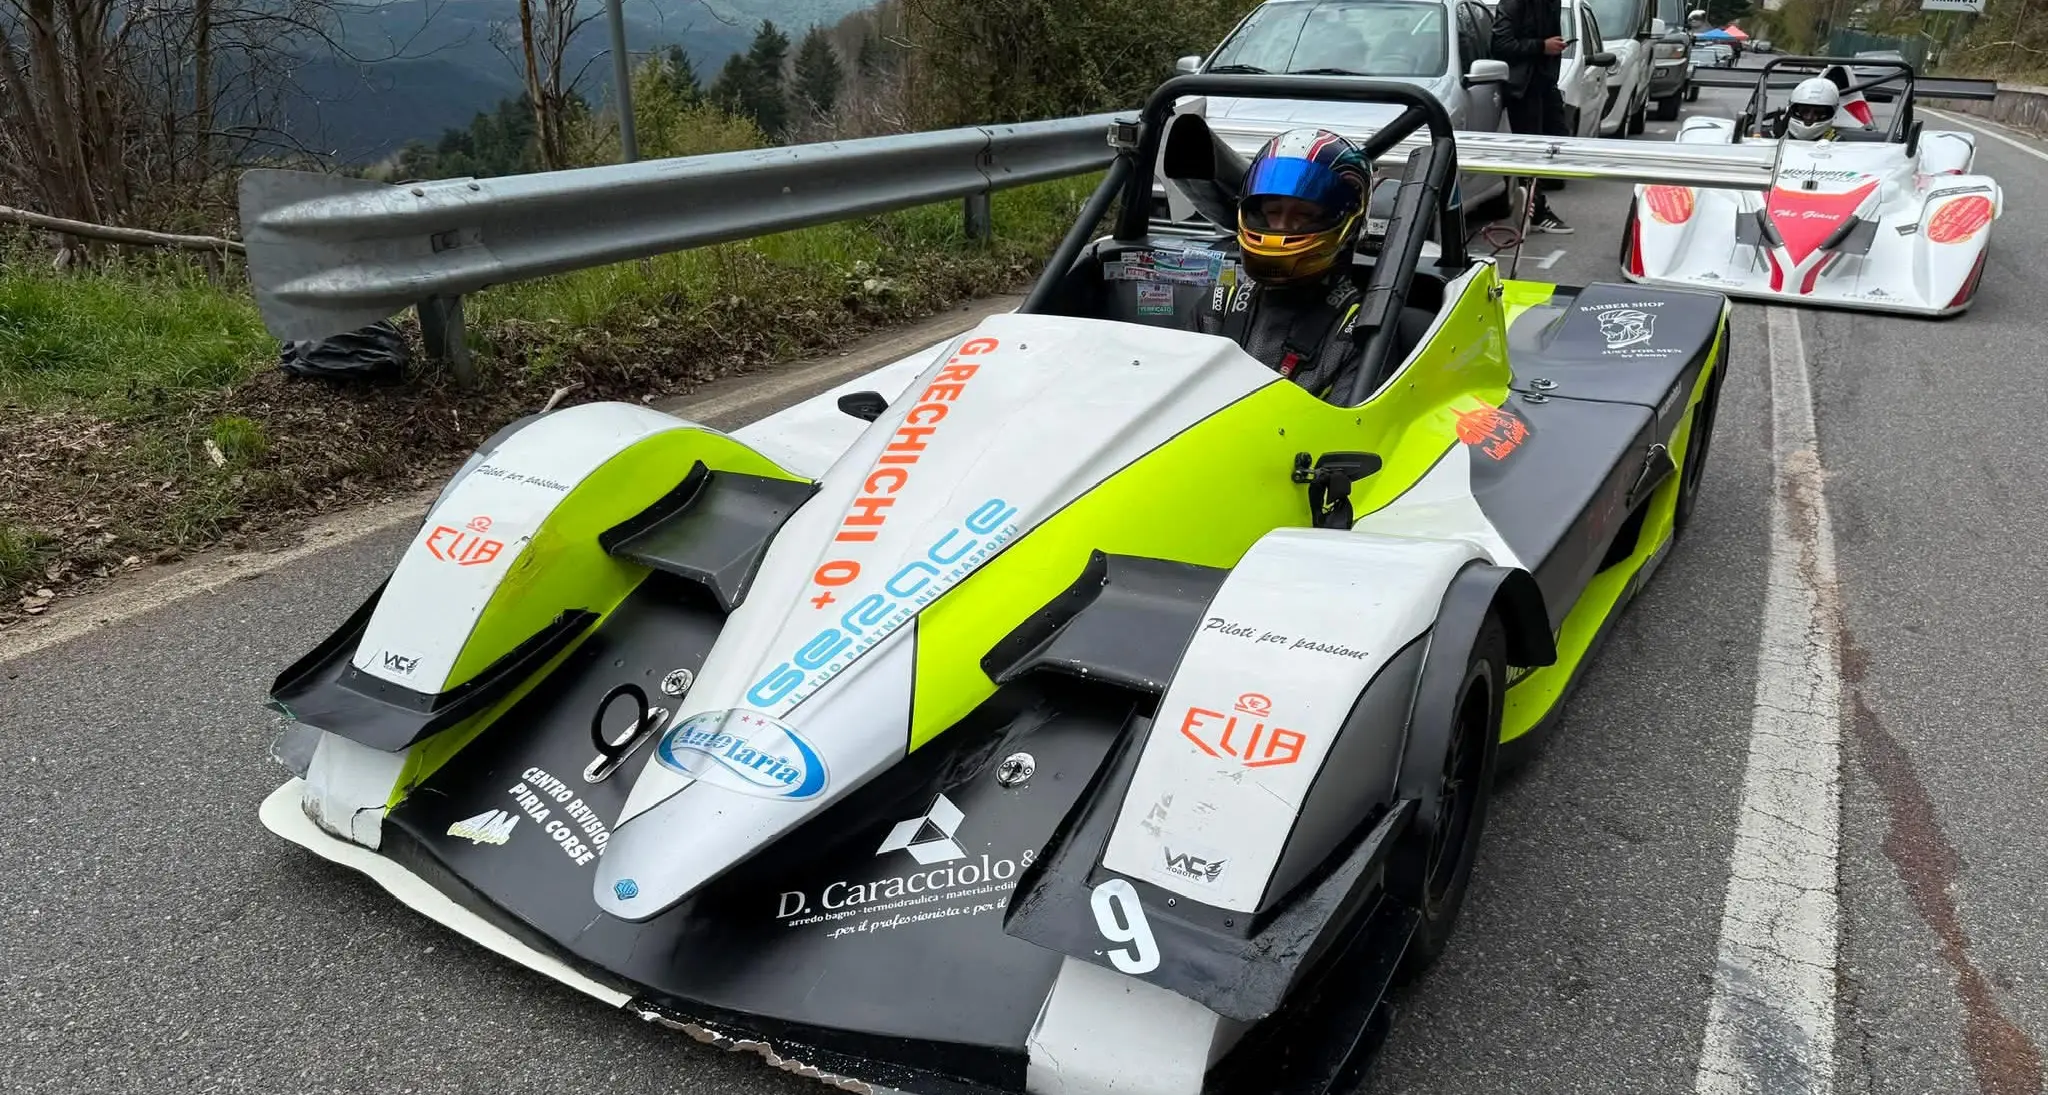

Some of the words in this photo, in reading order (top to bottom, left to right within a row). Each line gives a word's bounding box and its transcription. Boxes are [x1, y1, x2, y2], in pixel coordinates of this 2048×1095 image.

[1580, 302, 1630, 312] BARBER
[834, 337, 999, 542] G.RECHICHI
[473, 464, 509, 477] Piloti
[502, 472, 524, 481] per
[521, 476, 570, 491] passione
[426, 525, 504, 566] ELIA
[788, 690, 807, 704] IL
[808, 663, 842, 688] TUO
[847, 607, 914, 660] PARTNER
[914, 584, 942, 606] NEI
[942, 523, 1019, 584] TRASPORTI
[1203, 617, 1256, 638] Piloti
[1255, 631, 1288, 644] per
[1289, 637, 1369, 660] passione
[1180, 706, 1307, 767] ELIA
[521, 767, 574, 803] CENTRO
[508, 782, 551, 824] PIRIA
[545, 820, 596, 866] CORSE
[776, 891, 811, 919] D.
[822, 854, 1016, 910] Caracciolo
[1020, 849, 1039, 868] &
[788, 914, 824, 927] arredo
[825, 909, 856, 921] bagno
[863, 892, 939, 914] termoidraulica
[946, 885, 993, 900] materiali
[994, 880, 1017, 891] edili
[858, 919, 868, 932] il
[870, 902, 960, 933] professionista
[963, 905, 971, 914] e
[972, 902, 994, 915] per
[996, 896, 1008, 909] il
[1091, 878, 1160, 974] 9
